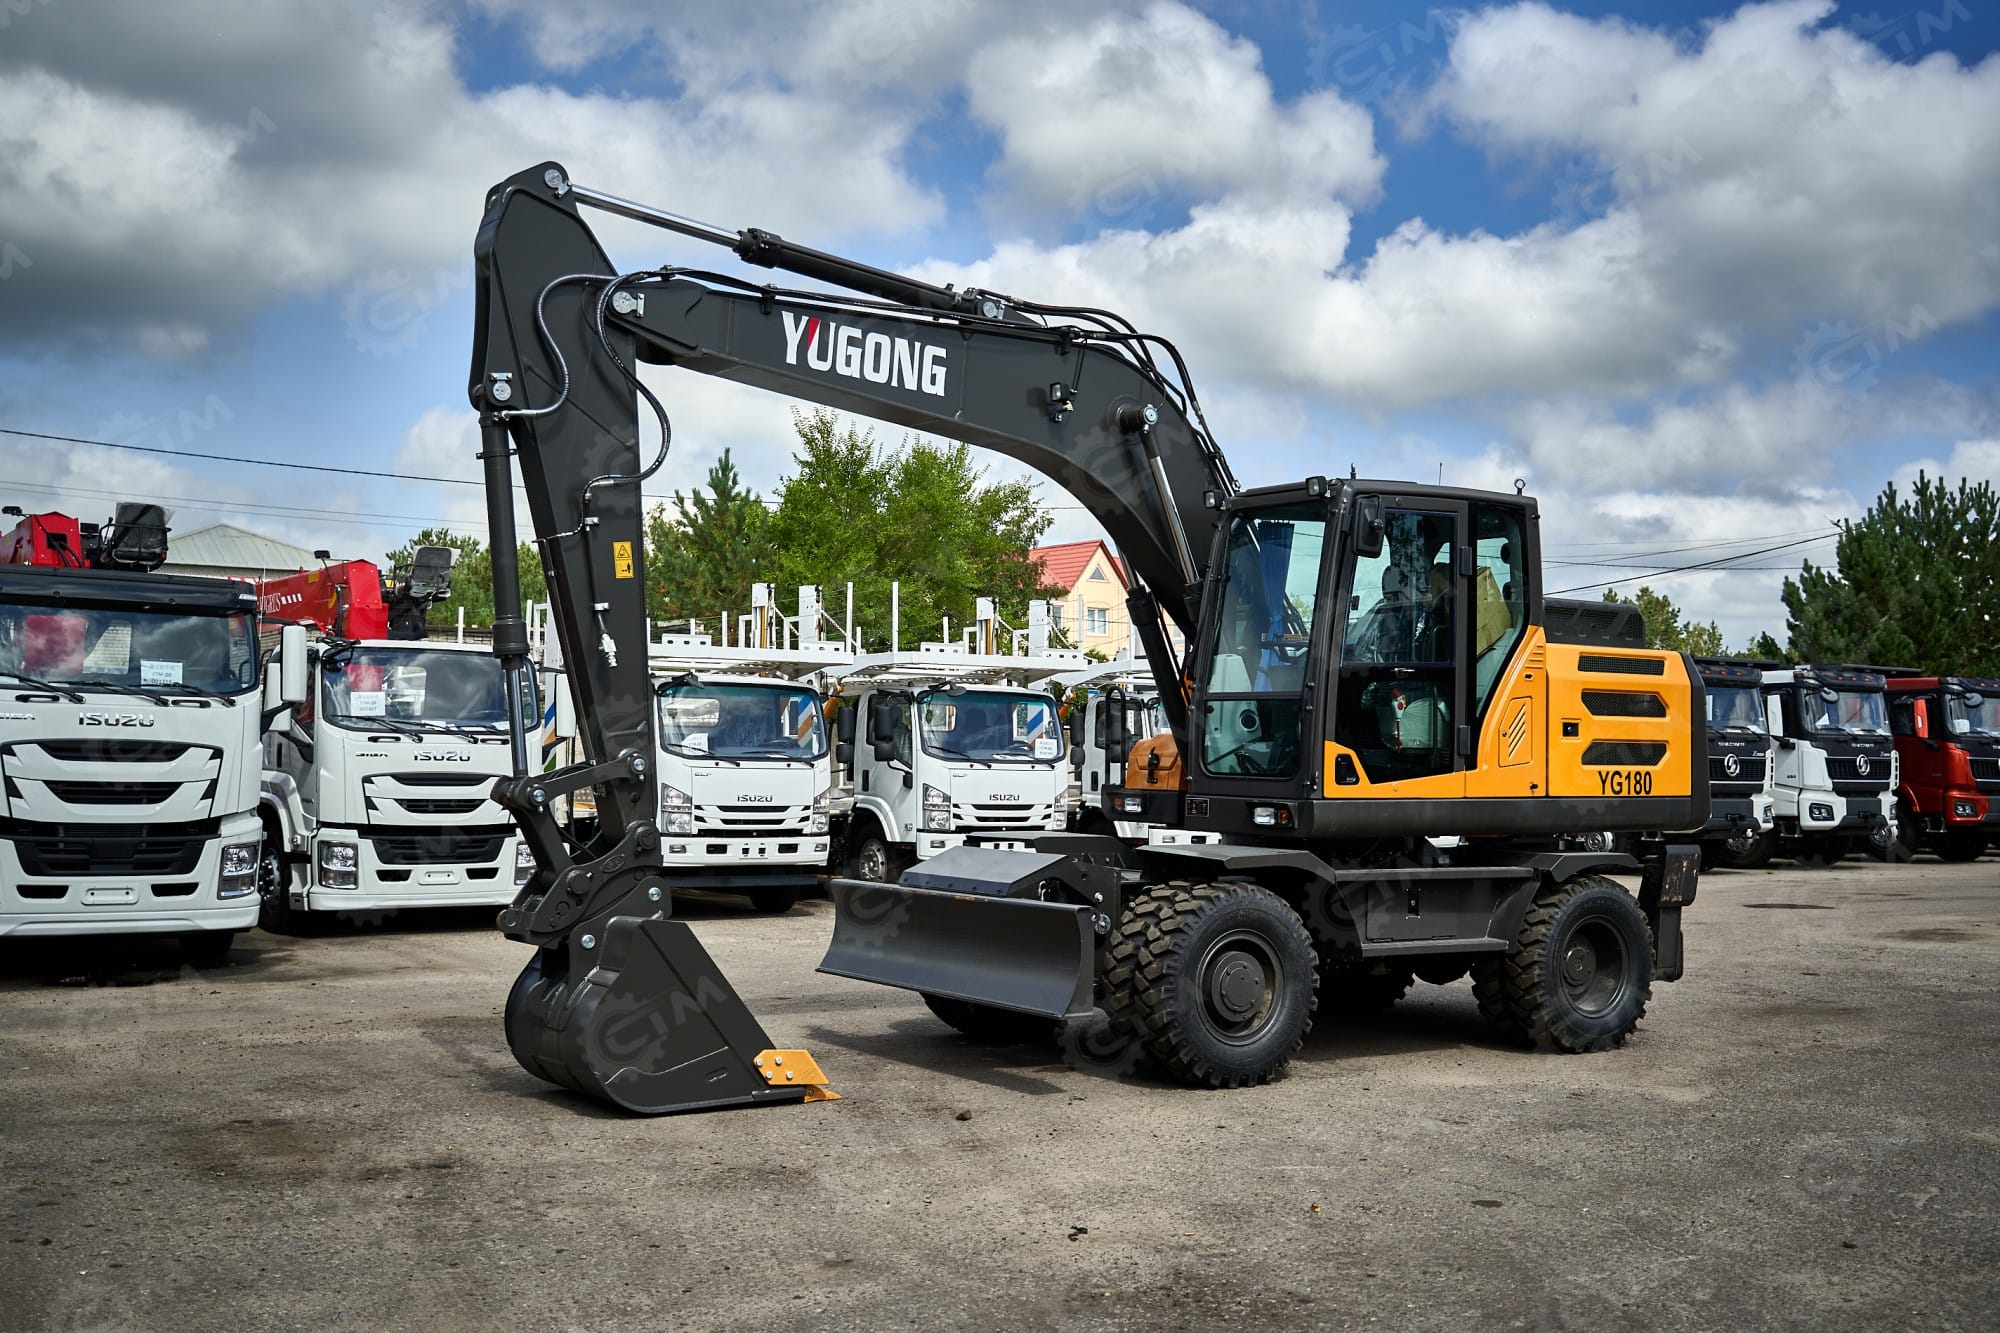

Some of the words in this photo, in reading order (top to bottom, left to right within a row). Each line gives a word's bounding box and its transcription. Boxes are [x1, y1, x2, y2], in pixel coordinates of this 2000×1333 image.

[781, 310, 947, 397] YUGONG
[78, 711, 155, 728] ISUZU
[413, 749, 471, 762] ISUZU
[1597, 770, 1653, 796] YG180
[737, 794, 773, 803] ISUZU
[989, 793, 1020, 801] ISUZU
